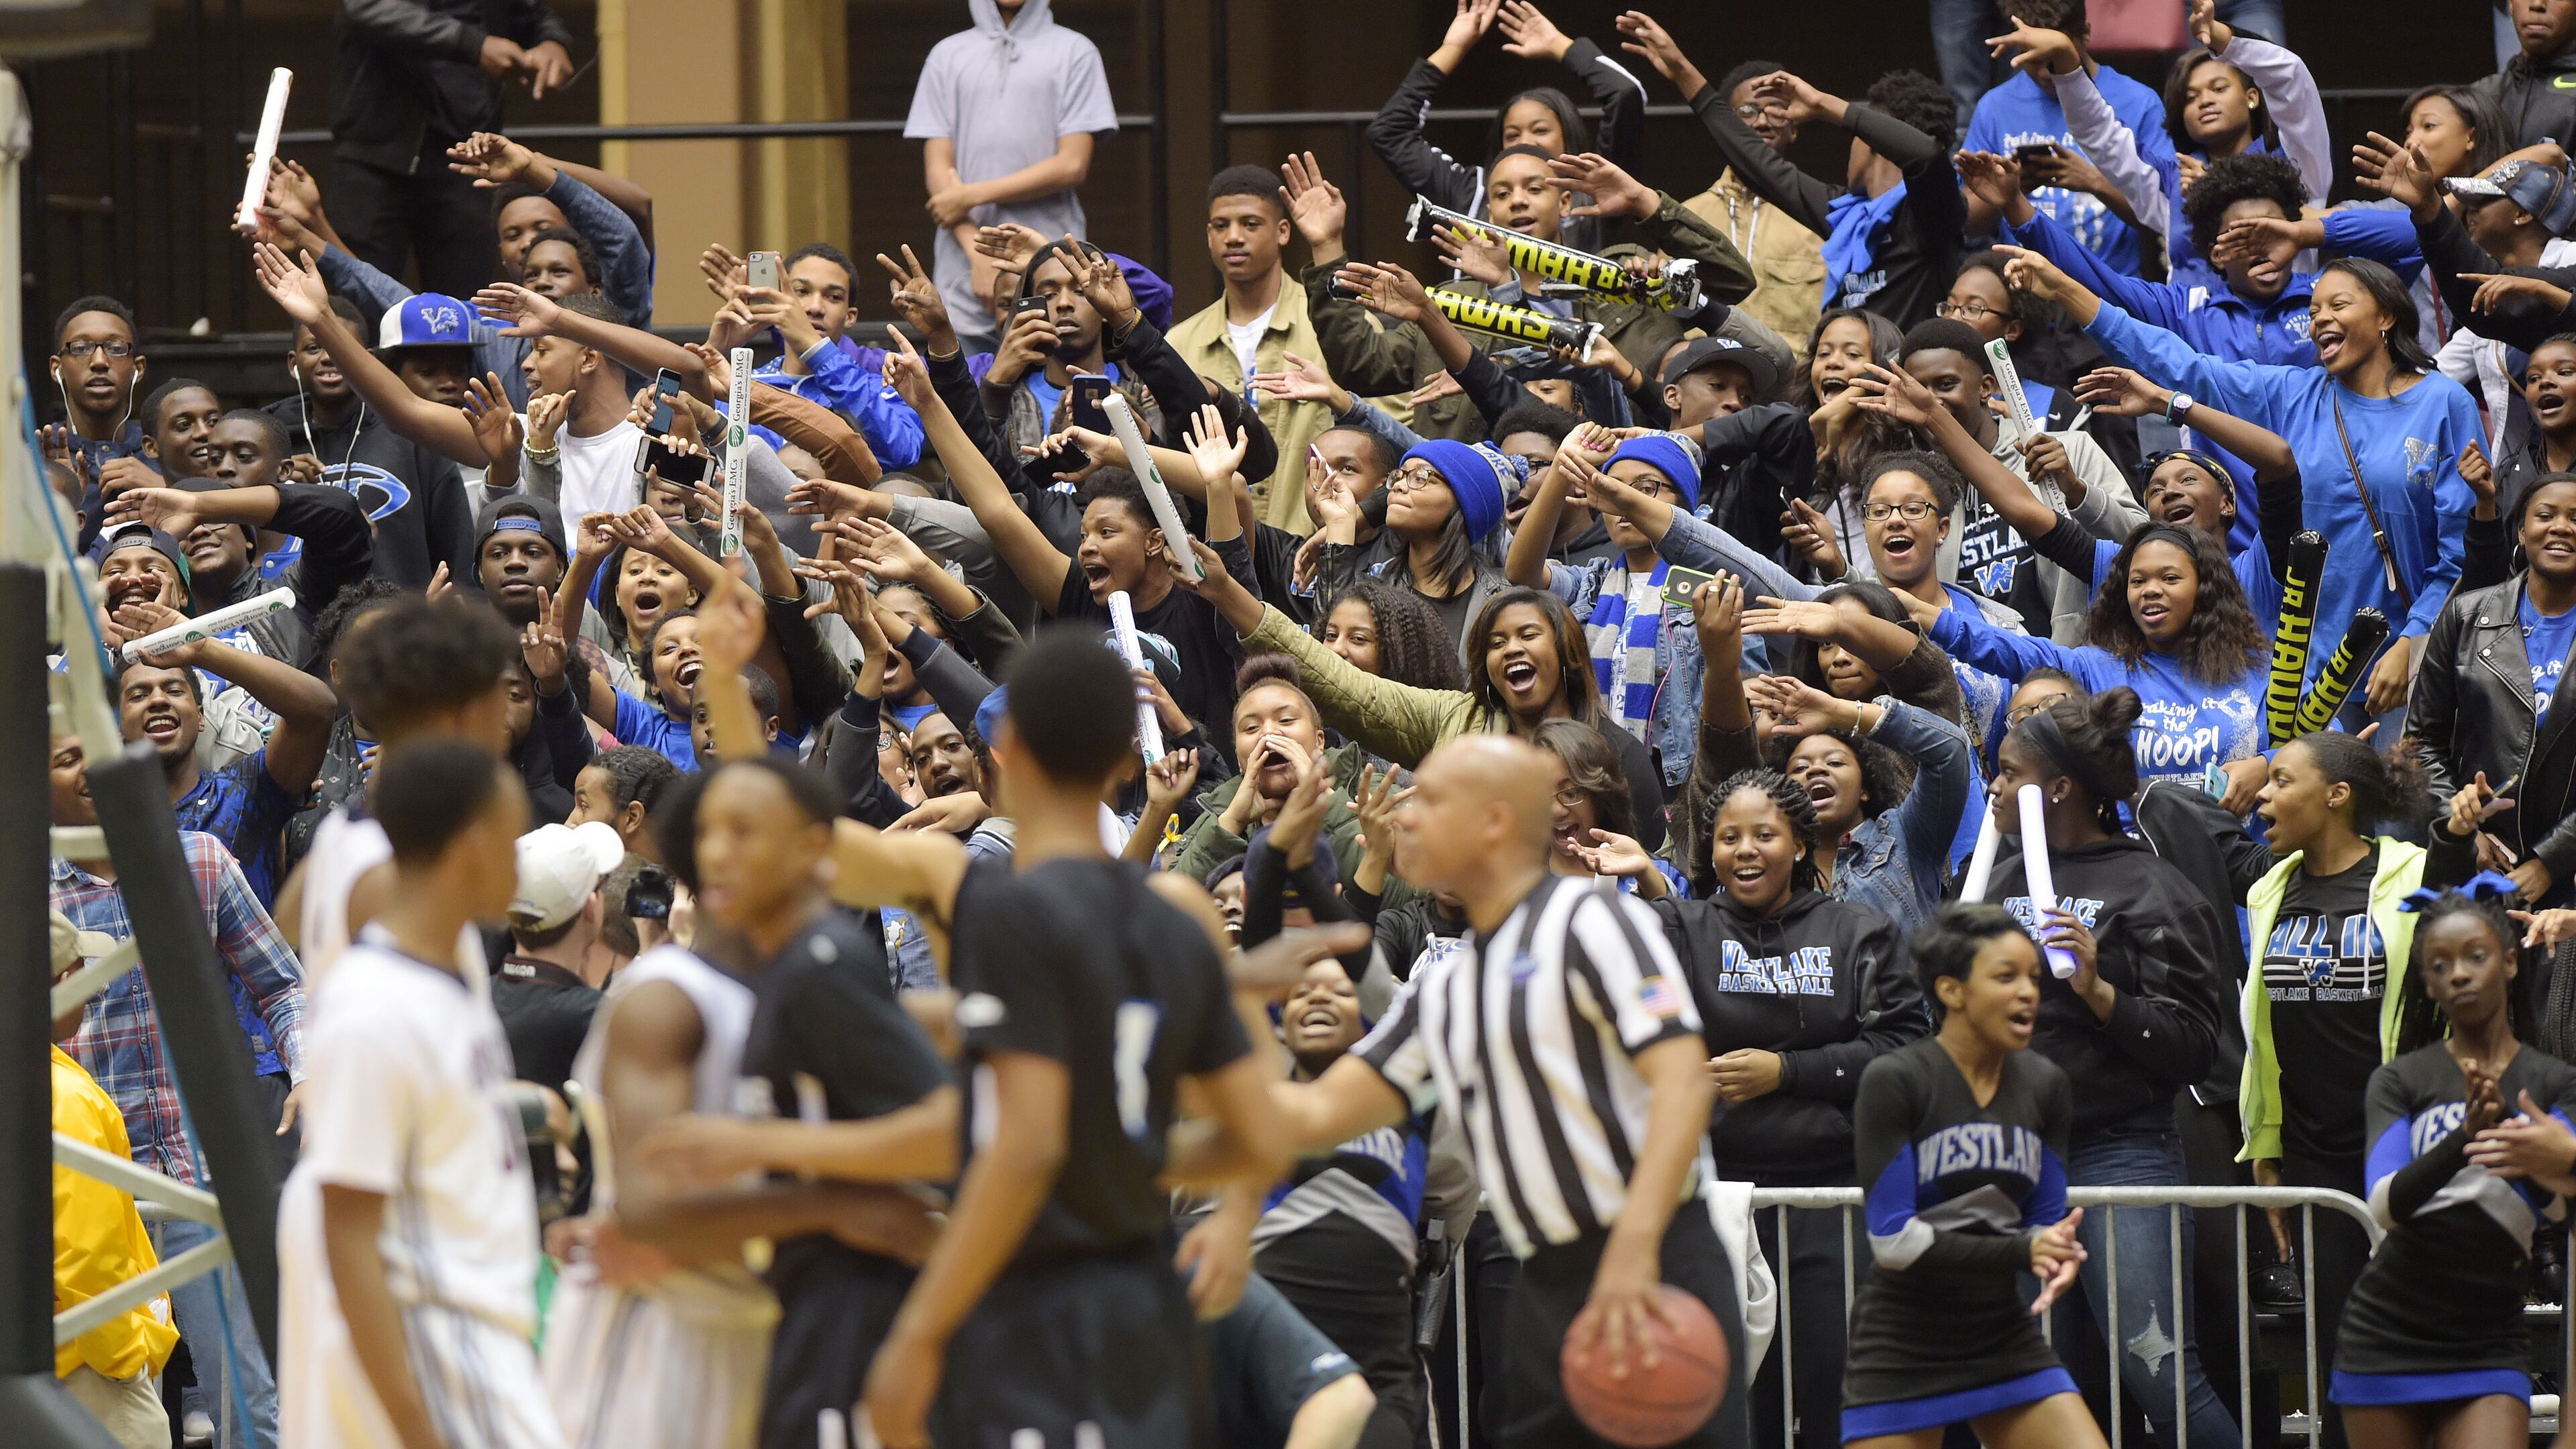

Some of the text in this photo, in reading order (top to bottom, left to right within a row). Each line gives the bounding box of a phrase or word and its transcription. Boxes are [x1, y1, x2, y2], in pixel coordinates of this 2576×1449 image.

[1425, 286, 1554, 340] AWKS
[733, 351, 745, 421] Georgia's EMCs
[2005, 363, 2033, 429] Georgia's EMCs
[729, 459, 738, 487] EMCs
[2045, 473, 2061, 500] orgia's
[1959, 525, 2029, 569] STLA
[2163, 714, 2188, 732] the
[2137, 725, 2220, 769] HOOP!
[2265, 914, 2385, 959] ALL IN
[1721, 939, 1834, 981] WESTLAKE
[2267, 987, 2310, 1002] STLAKE
